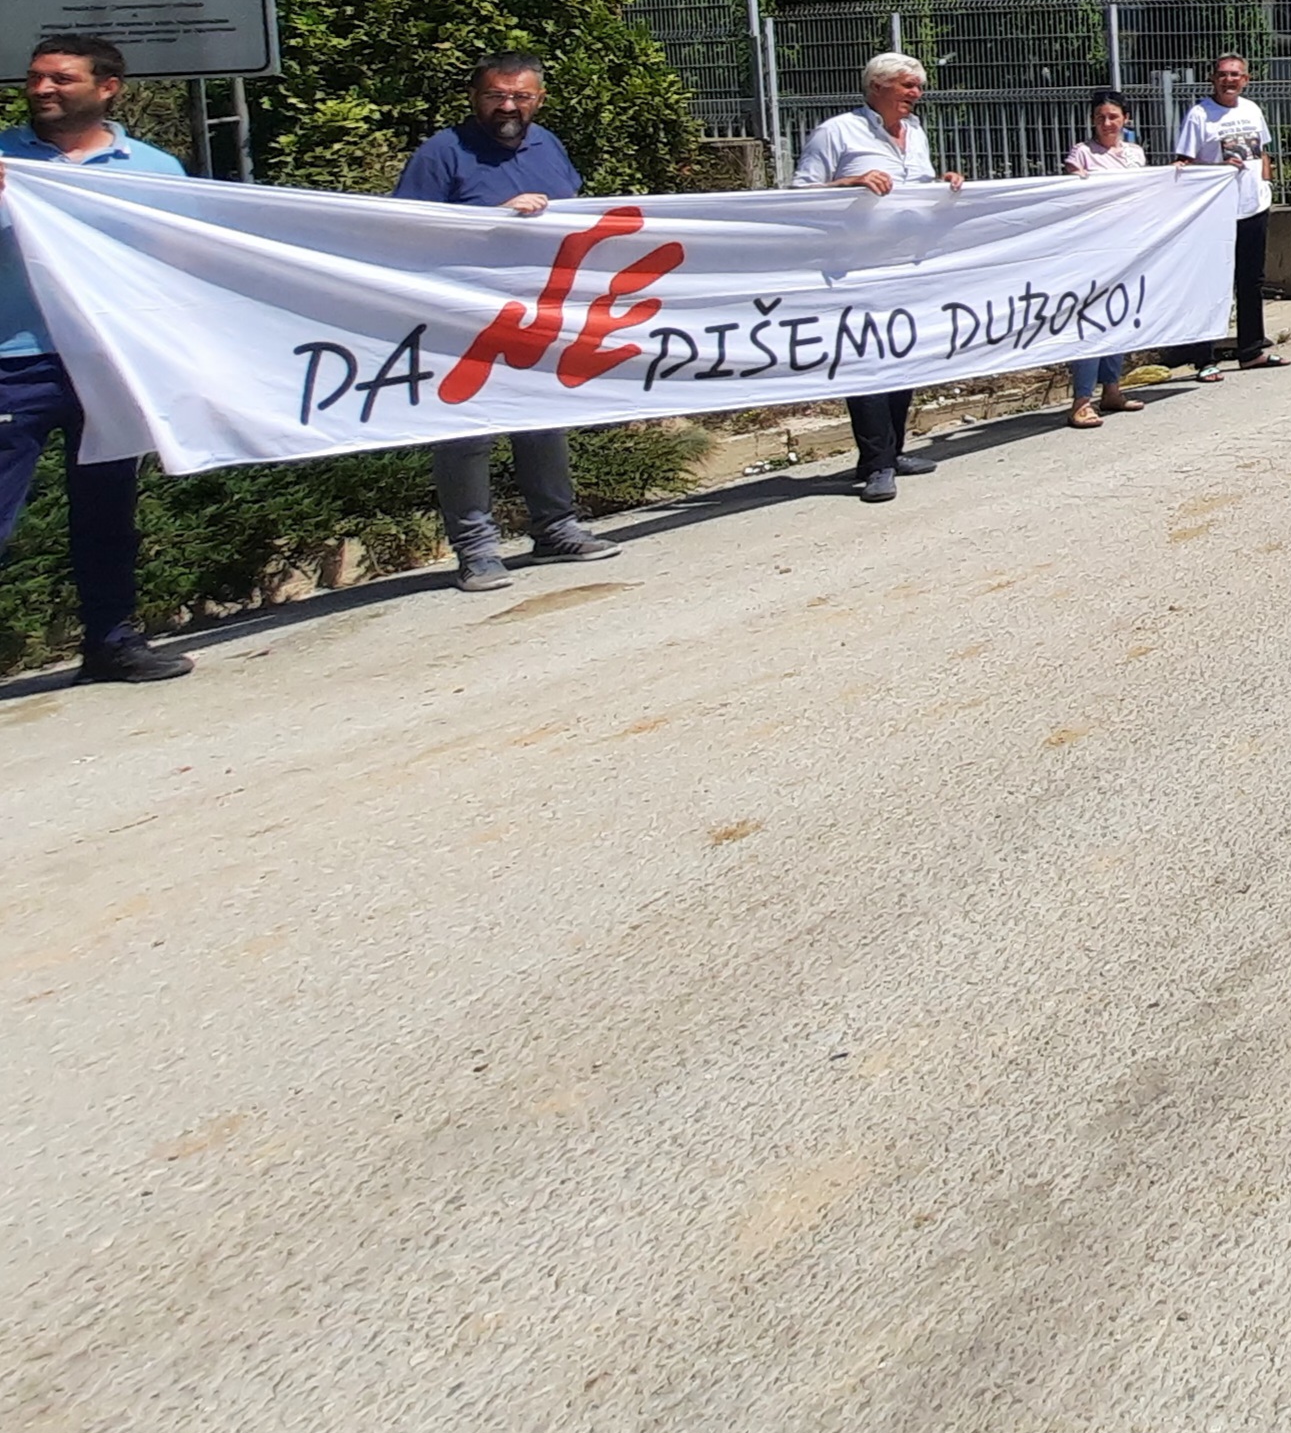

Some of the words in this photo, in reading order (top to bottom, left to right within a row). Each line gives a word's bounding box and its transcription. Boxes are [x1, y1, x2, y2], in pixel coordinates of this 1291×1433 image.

[293, 323, 435, 425] DA
[438, 206, 684, 404] NE
[643, 297, 917, 392] DIŠEMO
[942, 274, 1146, 361] DUBOKO!
